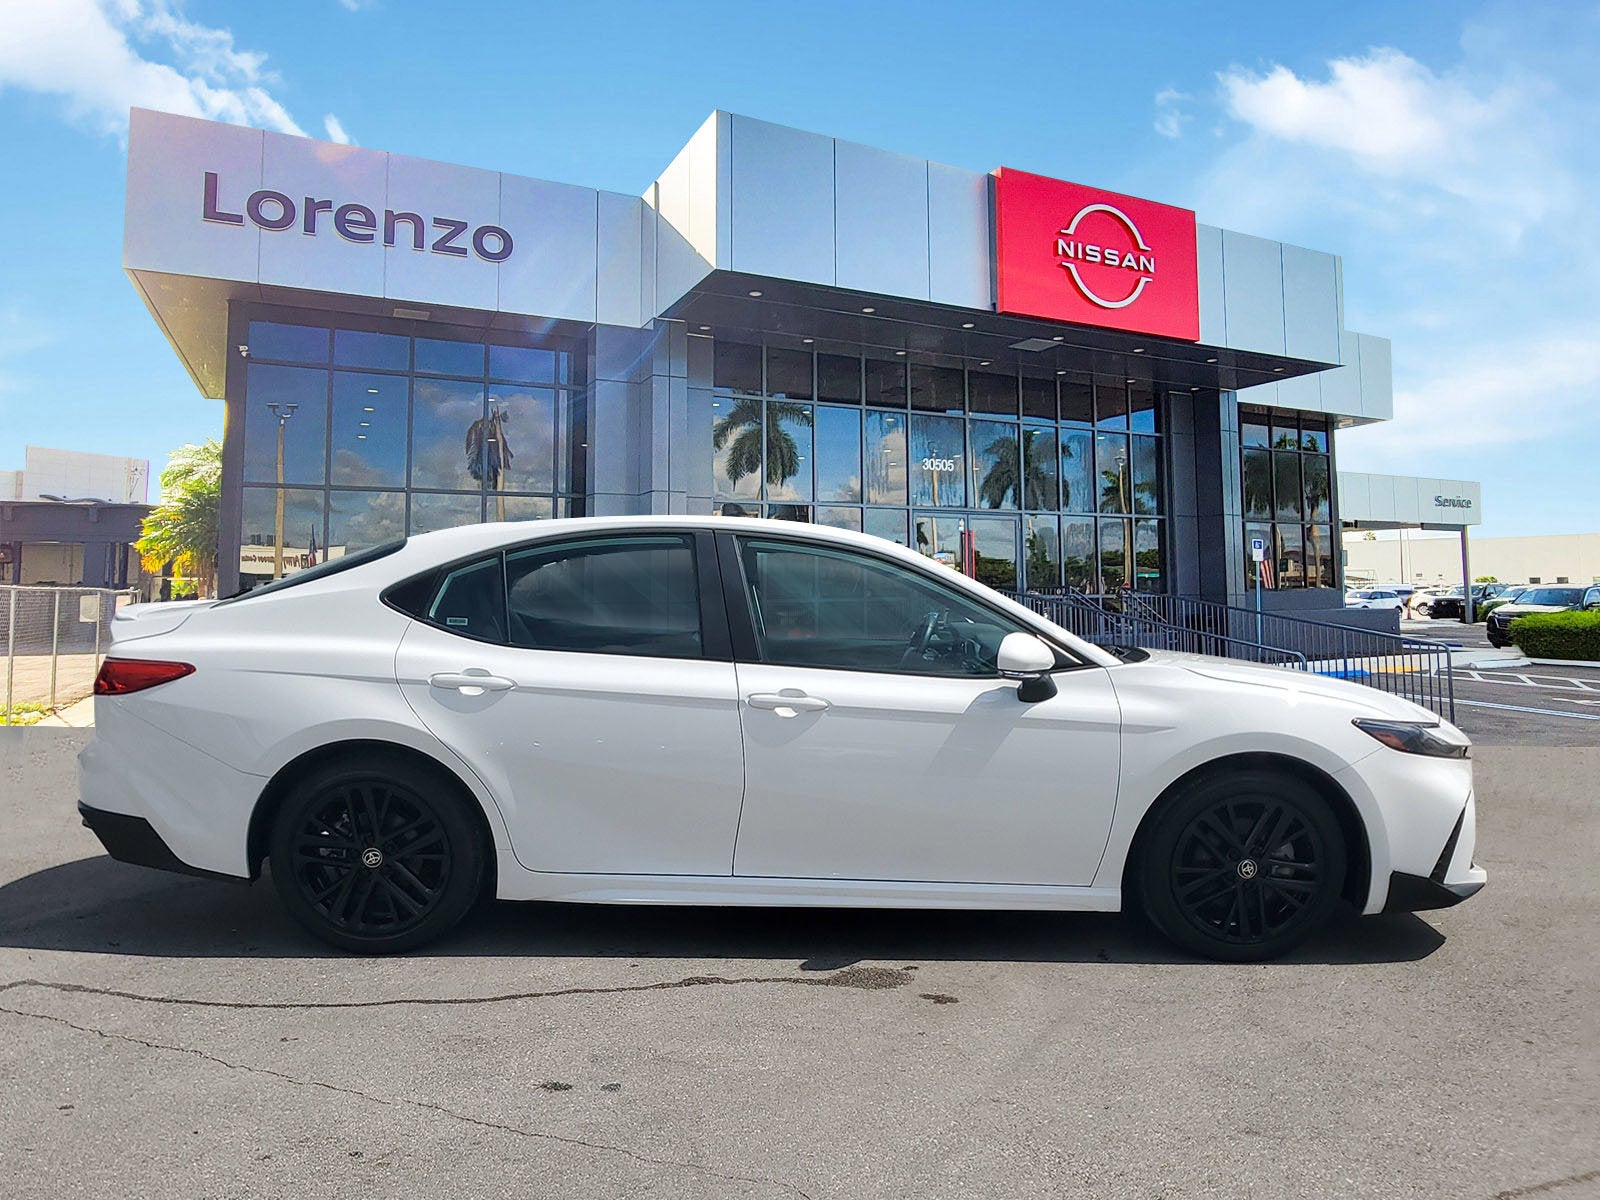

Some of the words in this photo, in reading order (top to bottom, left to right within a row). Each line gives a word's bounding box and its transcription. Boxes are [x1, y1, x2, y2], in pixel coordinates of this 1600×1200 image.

[202, 171, 515, 262] Lorenzo
[1057, 238, 1155, 273] NISSAN
[922, 458, 955, 471] 30505
[1433, 495, 1472, 508] Service
